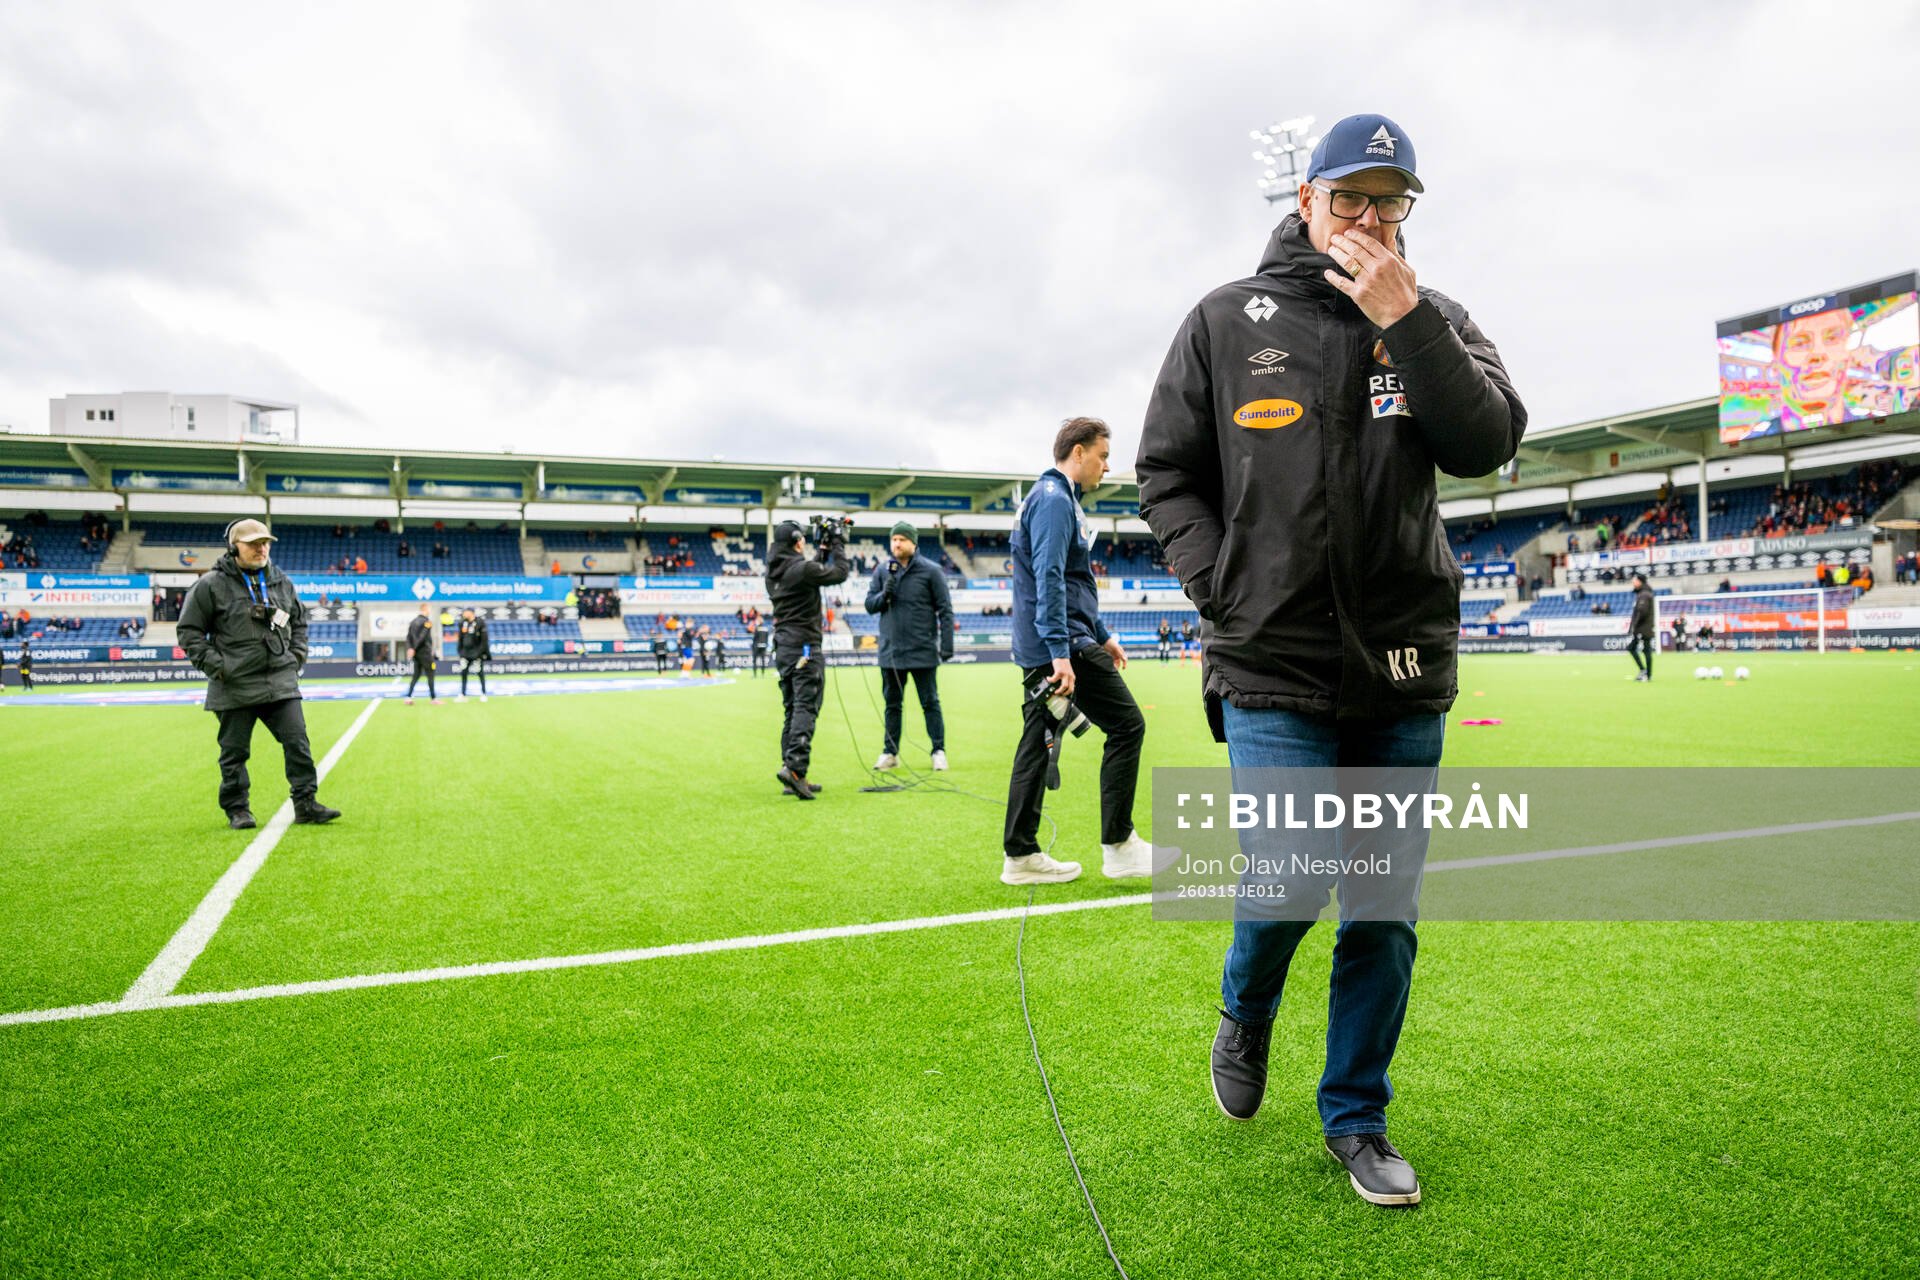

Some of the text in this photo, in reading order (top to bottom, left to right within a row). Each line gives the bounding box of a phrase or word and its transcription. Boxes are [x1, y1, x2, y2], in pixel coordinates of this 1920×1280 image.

[1365, 145, 1395, 158] assist
[1790, 298, 1826, 315] coop
[1251, 365, 1285, 375] umbro
[1239, 406, 1296, 420] Sundolitt
[45, 592, 140, 602] INTERSPORT
[636, 592, 706, 601] INTERSPORT
[731, 593, 764, 601] INTER
[1386, 647, 1422, 681] KR
[30, 671, 76, 685] Revisjon
[78, 671, 94, 684] og
[96, 667, 156, 682] rådgivning
[157, 668, 172, 680] for
[174, 669, 186, 679] et
